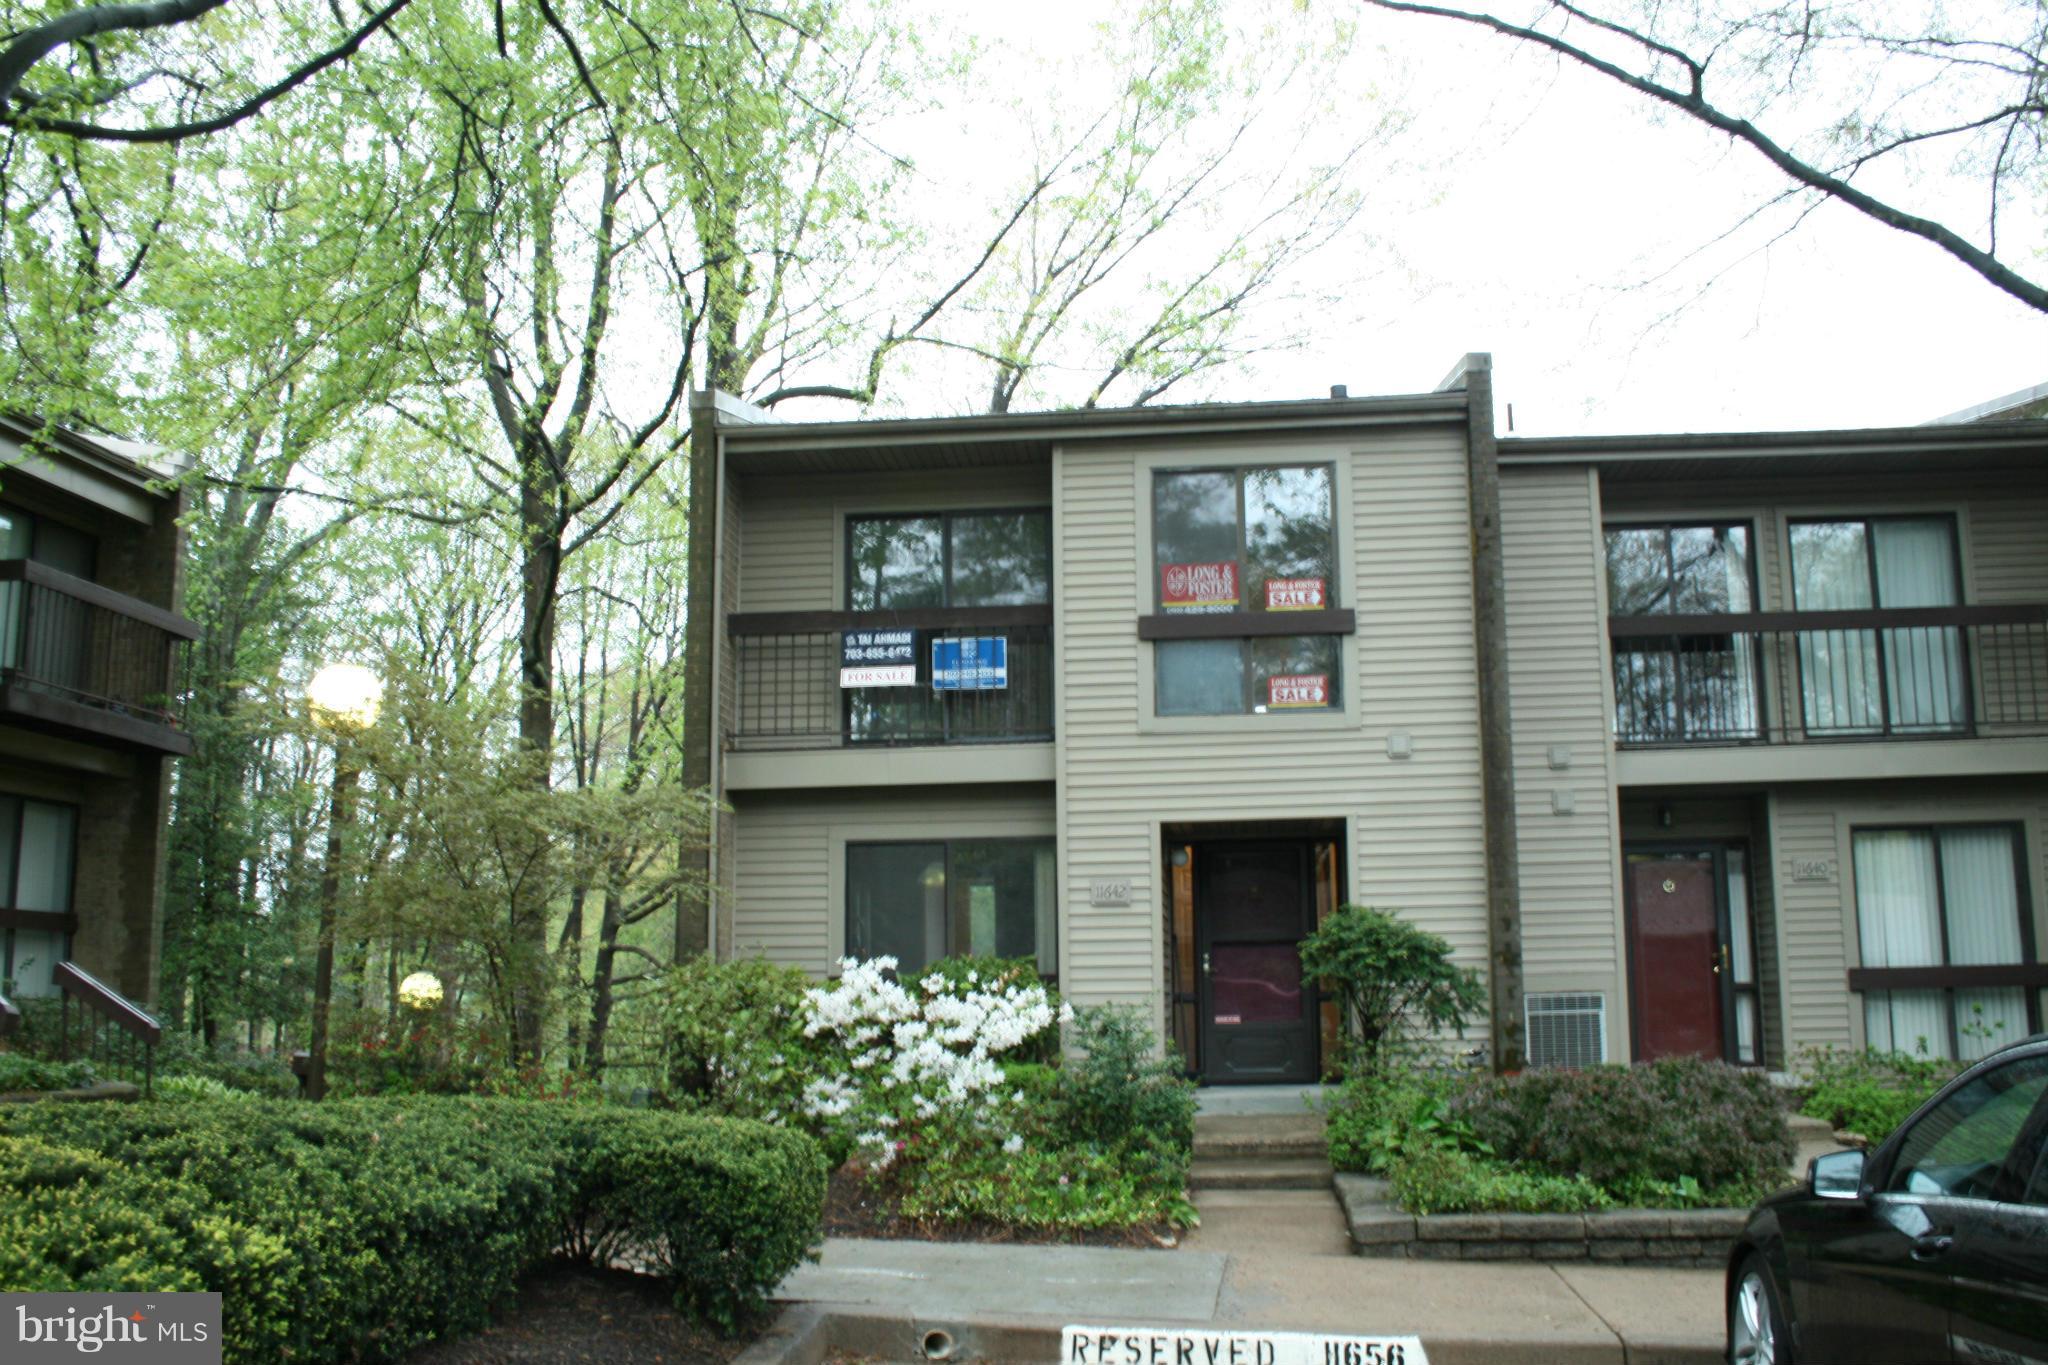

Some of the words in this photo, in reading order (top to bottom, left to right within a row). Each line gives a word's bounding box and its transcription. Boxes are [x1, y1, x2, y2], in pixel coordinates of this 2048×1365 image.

[1187, 564, 1219, 580] LONG
[1223, 564, 1233, 580] &
[1188, 578, 1233, 595] FOSTER
[1268, 581, 1288, 591] LONG
[1272, 591, 1313, 605] SALE
[847, 671, 872, 682] FOR
[876, 670, 908, 681] SALE
[1271, 678, 1289, 688] LONG
[1275, 688, 1316, 701] SALE
[1071, 1333, 1275, 1365] RESERVED
